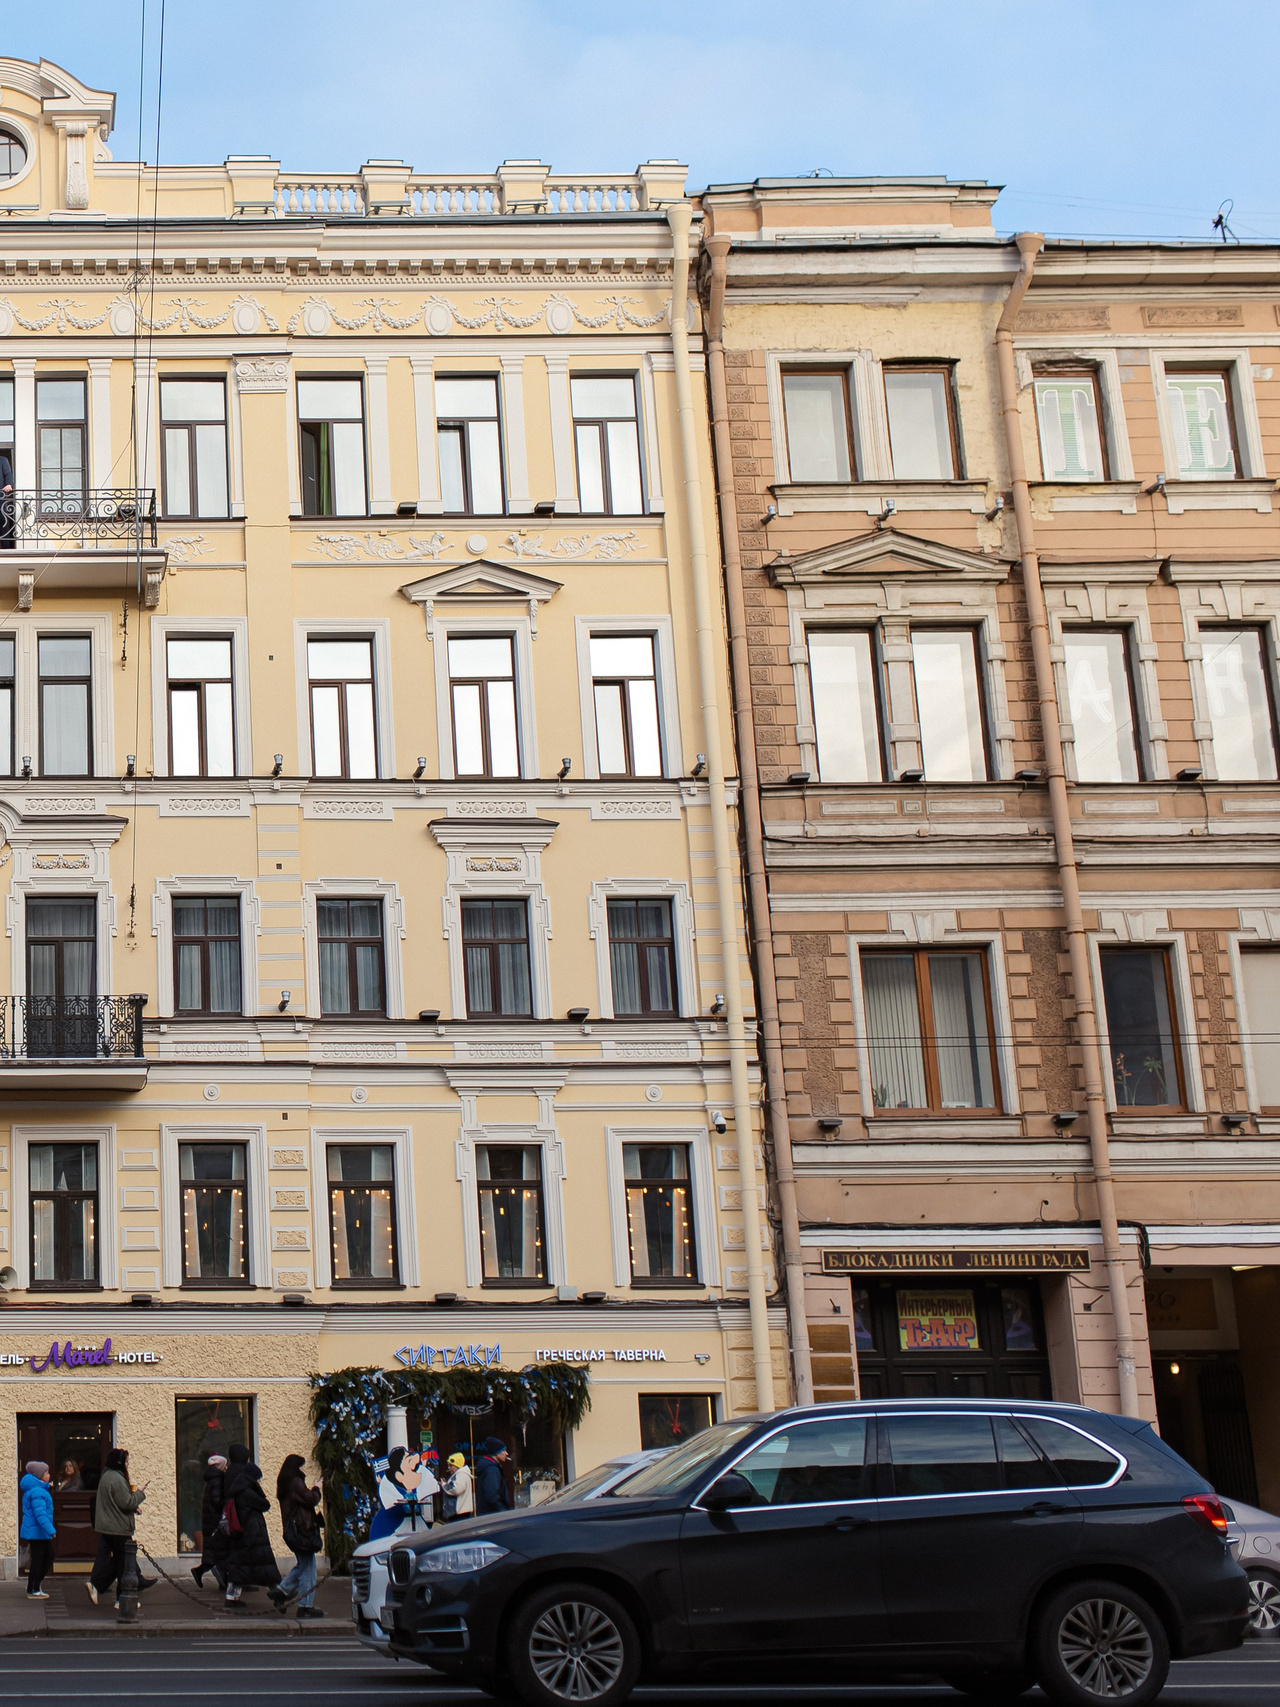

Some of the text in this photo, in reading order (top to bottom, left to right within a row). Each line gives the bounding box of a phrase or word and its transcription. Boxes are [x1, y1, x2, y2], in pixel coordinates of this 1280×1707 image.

[827, 1253, 1086, 1269] БЛОКАДНИКИ ЛЕНИНГРАДА
[30, 1337, 113, 1372] Marel
[118, 1351, 159, 1363] HOTEL
[394, 1341, 502, 1367] СИРТАКИ
[535, 1349, 667, 1361] ГРЕЧЕСКАЯ ТАВЕРНА
